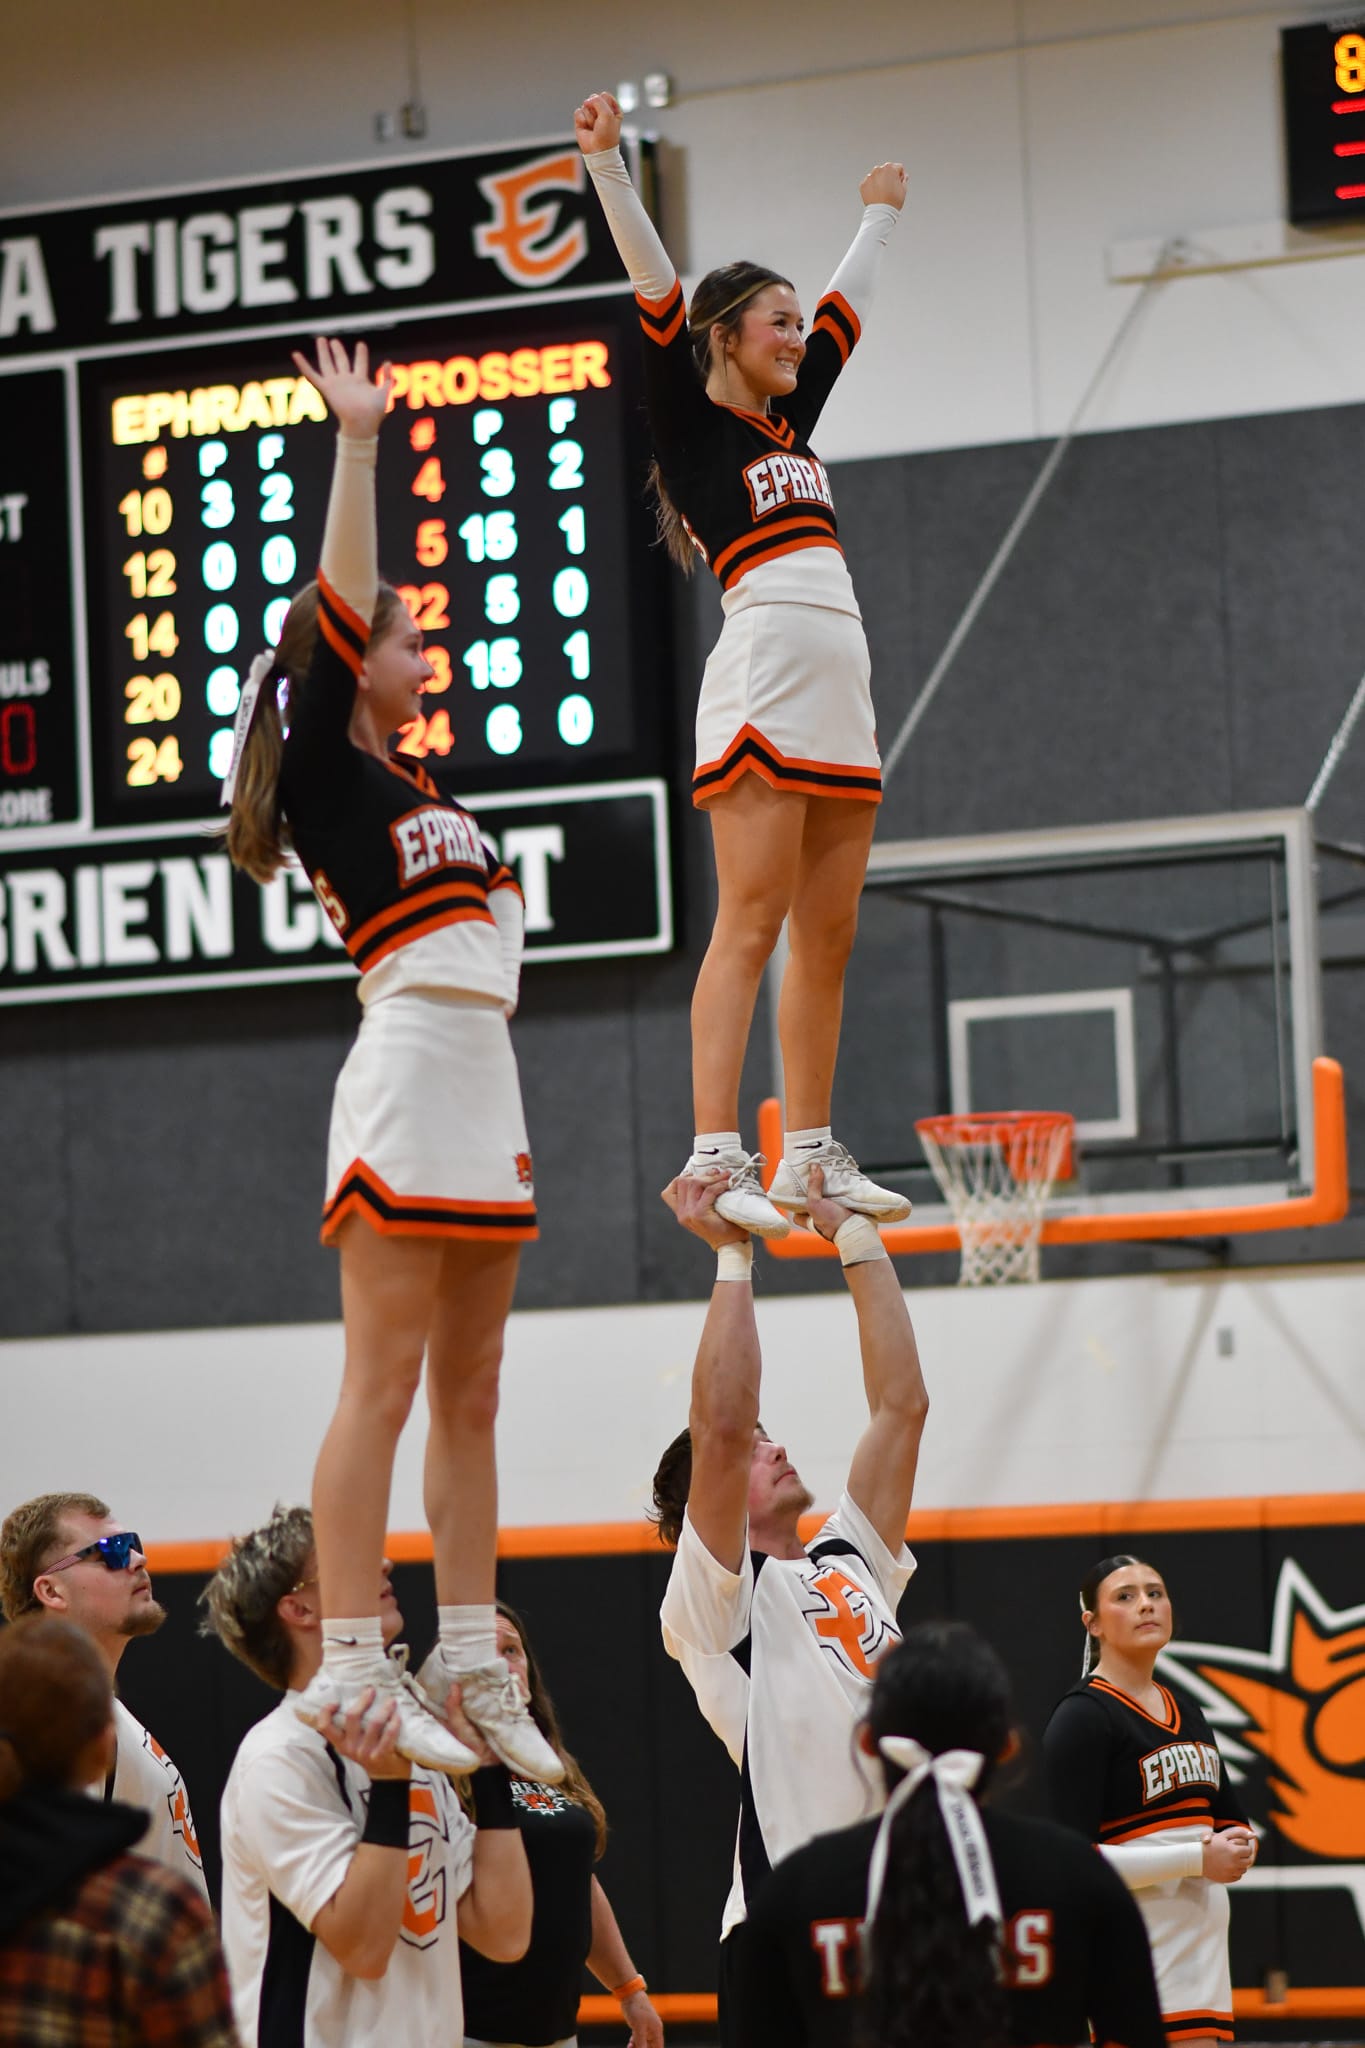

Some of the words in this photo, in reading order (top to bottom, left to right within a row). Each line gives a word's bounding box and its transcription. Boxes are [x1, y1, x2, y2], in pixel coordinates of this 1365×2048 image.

[95, 186, 435, 325] TIGERS
[376, 340, 612, 413] PROSSER
[112, 376, 328, 446] EPHRATA
[473, 408, 503, 445] P
[549, 397, 576, 434] F
[199, 440, 228, 477] P
[411, 456, 446, 502] 4
[480, 447, 516, 497] 3
[548, 439, 585, 490] 2
[119, 487, 173, 537] 10
[201, 479, 235, 529] 3
[260, 472, 295, 522] 2
[416, 518, 449, 567] 5
[458, 510, 518, 563] 15
[558, 505, 586, 555] 1
[123, 549, 177, 599] 12
[202, 541, 237, 591] 0
[261, 534, 297, 585] 0
[484, 573, 521, 625] 5
[553, 566, 590, 617] 0
[125, 611, 179, 661] 14
[204, 603, 239, 654] 0
[463, 636, 523, 690] 15
[562, 629, 590, 680] 1
[125, 673, 181, 725] 20
[206, 665, 240, 716] 6
[396, 709, 455, 758] 24
[486, 703, 523, 755] 6
[557, 694, 594, 746] 0
[2, 702, 37, 776] 0
[126, 735, 183, 787] 24
[0, 855, 235, 976] RIEN
